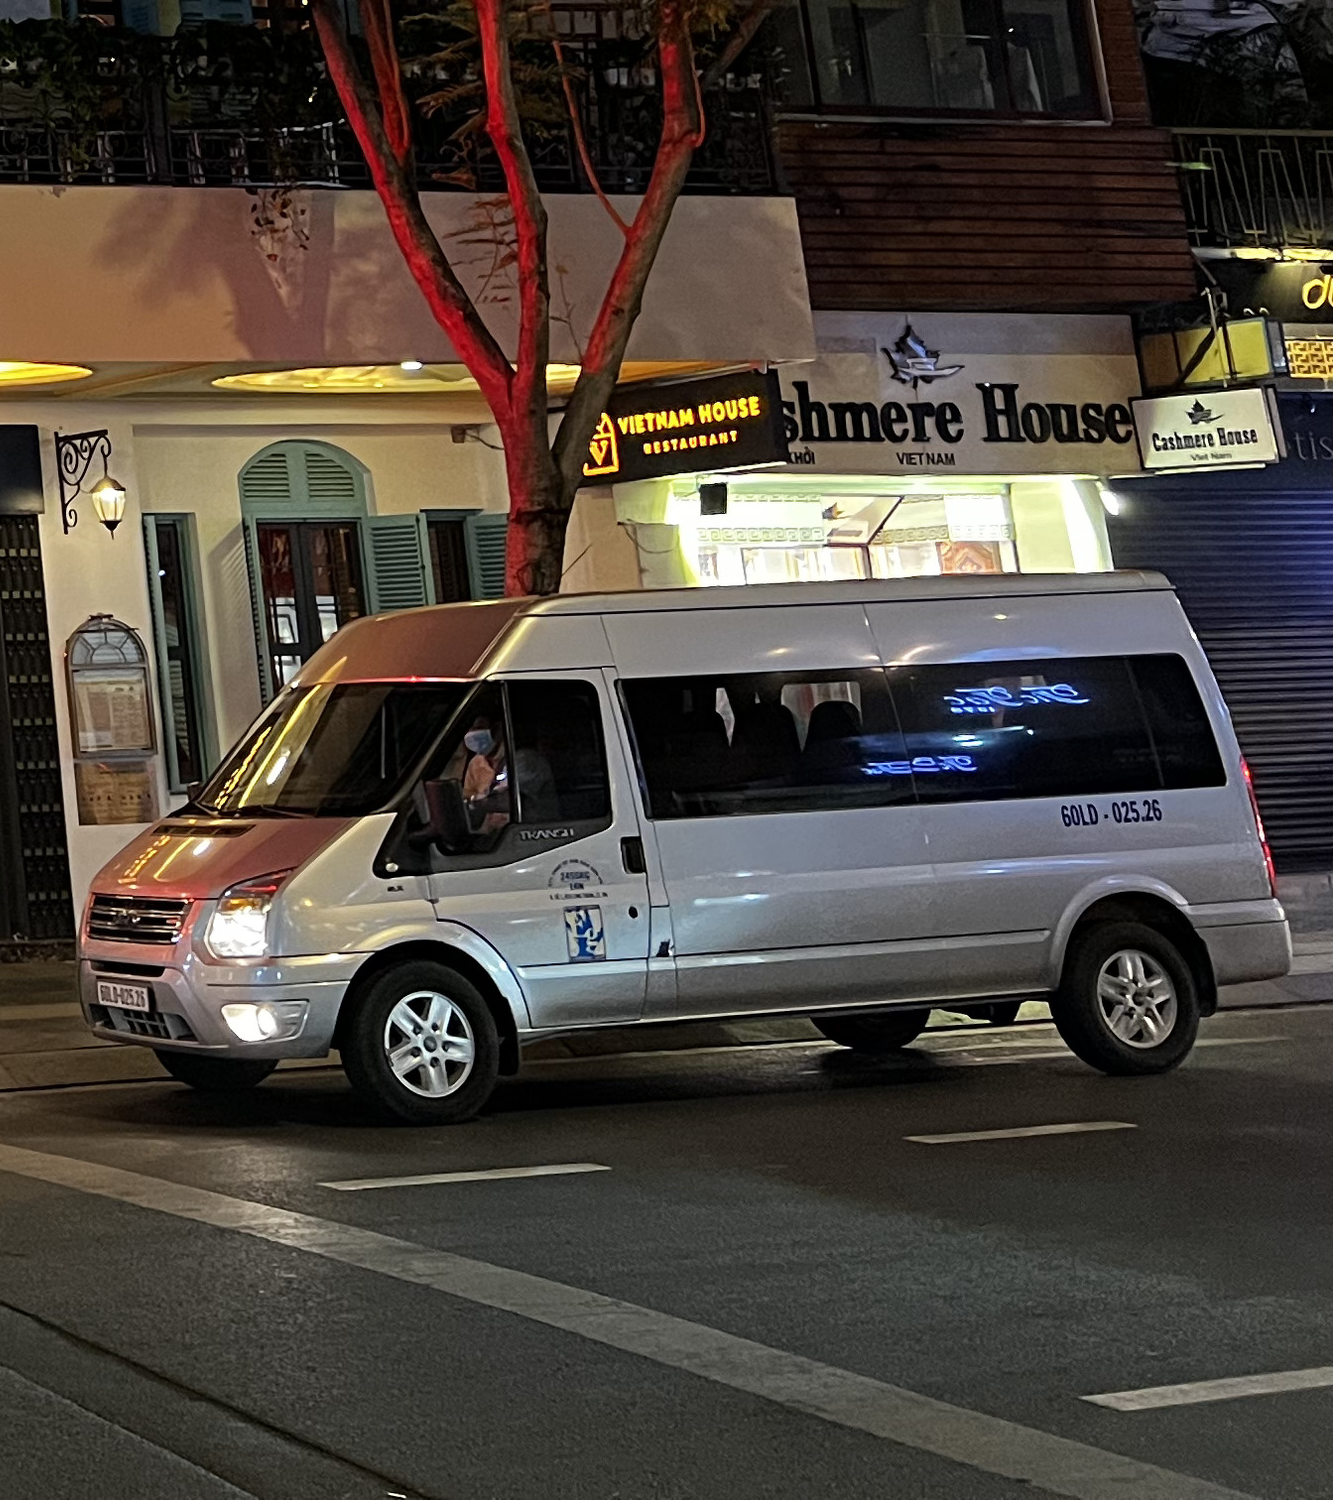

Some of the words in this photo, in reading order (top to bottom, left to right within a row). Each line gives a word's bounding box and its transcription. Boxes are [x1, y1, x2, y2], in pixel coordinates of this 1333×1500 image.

[618, 407, 694, 435] VIETNAM
[698, 395, 761, 424] HOUSE
[782, 381, 965, 444] shmere
[976, 382, 1134, 444] House
[643, 430, 738, 455] RESTAURANT
[1151, 432, 1214, 452] Cashmere
[1216, 427, 1258, 446] House
[1061, 804, 1099, 827] 60LD
[1111, 799, 1162, 823] 025.26
